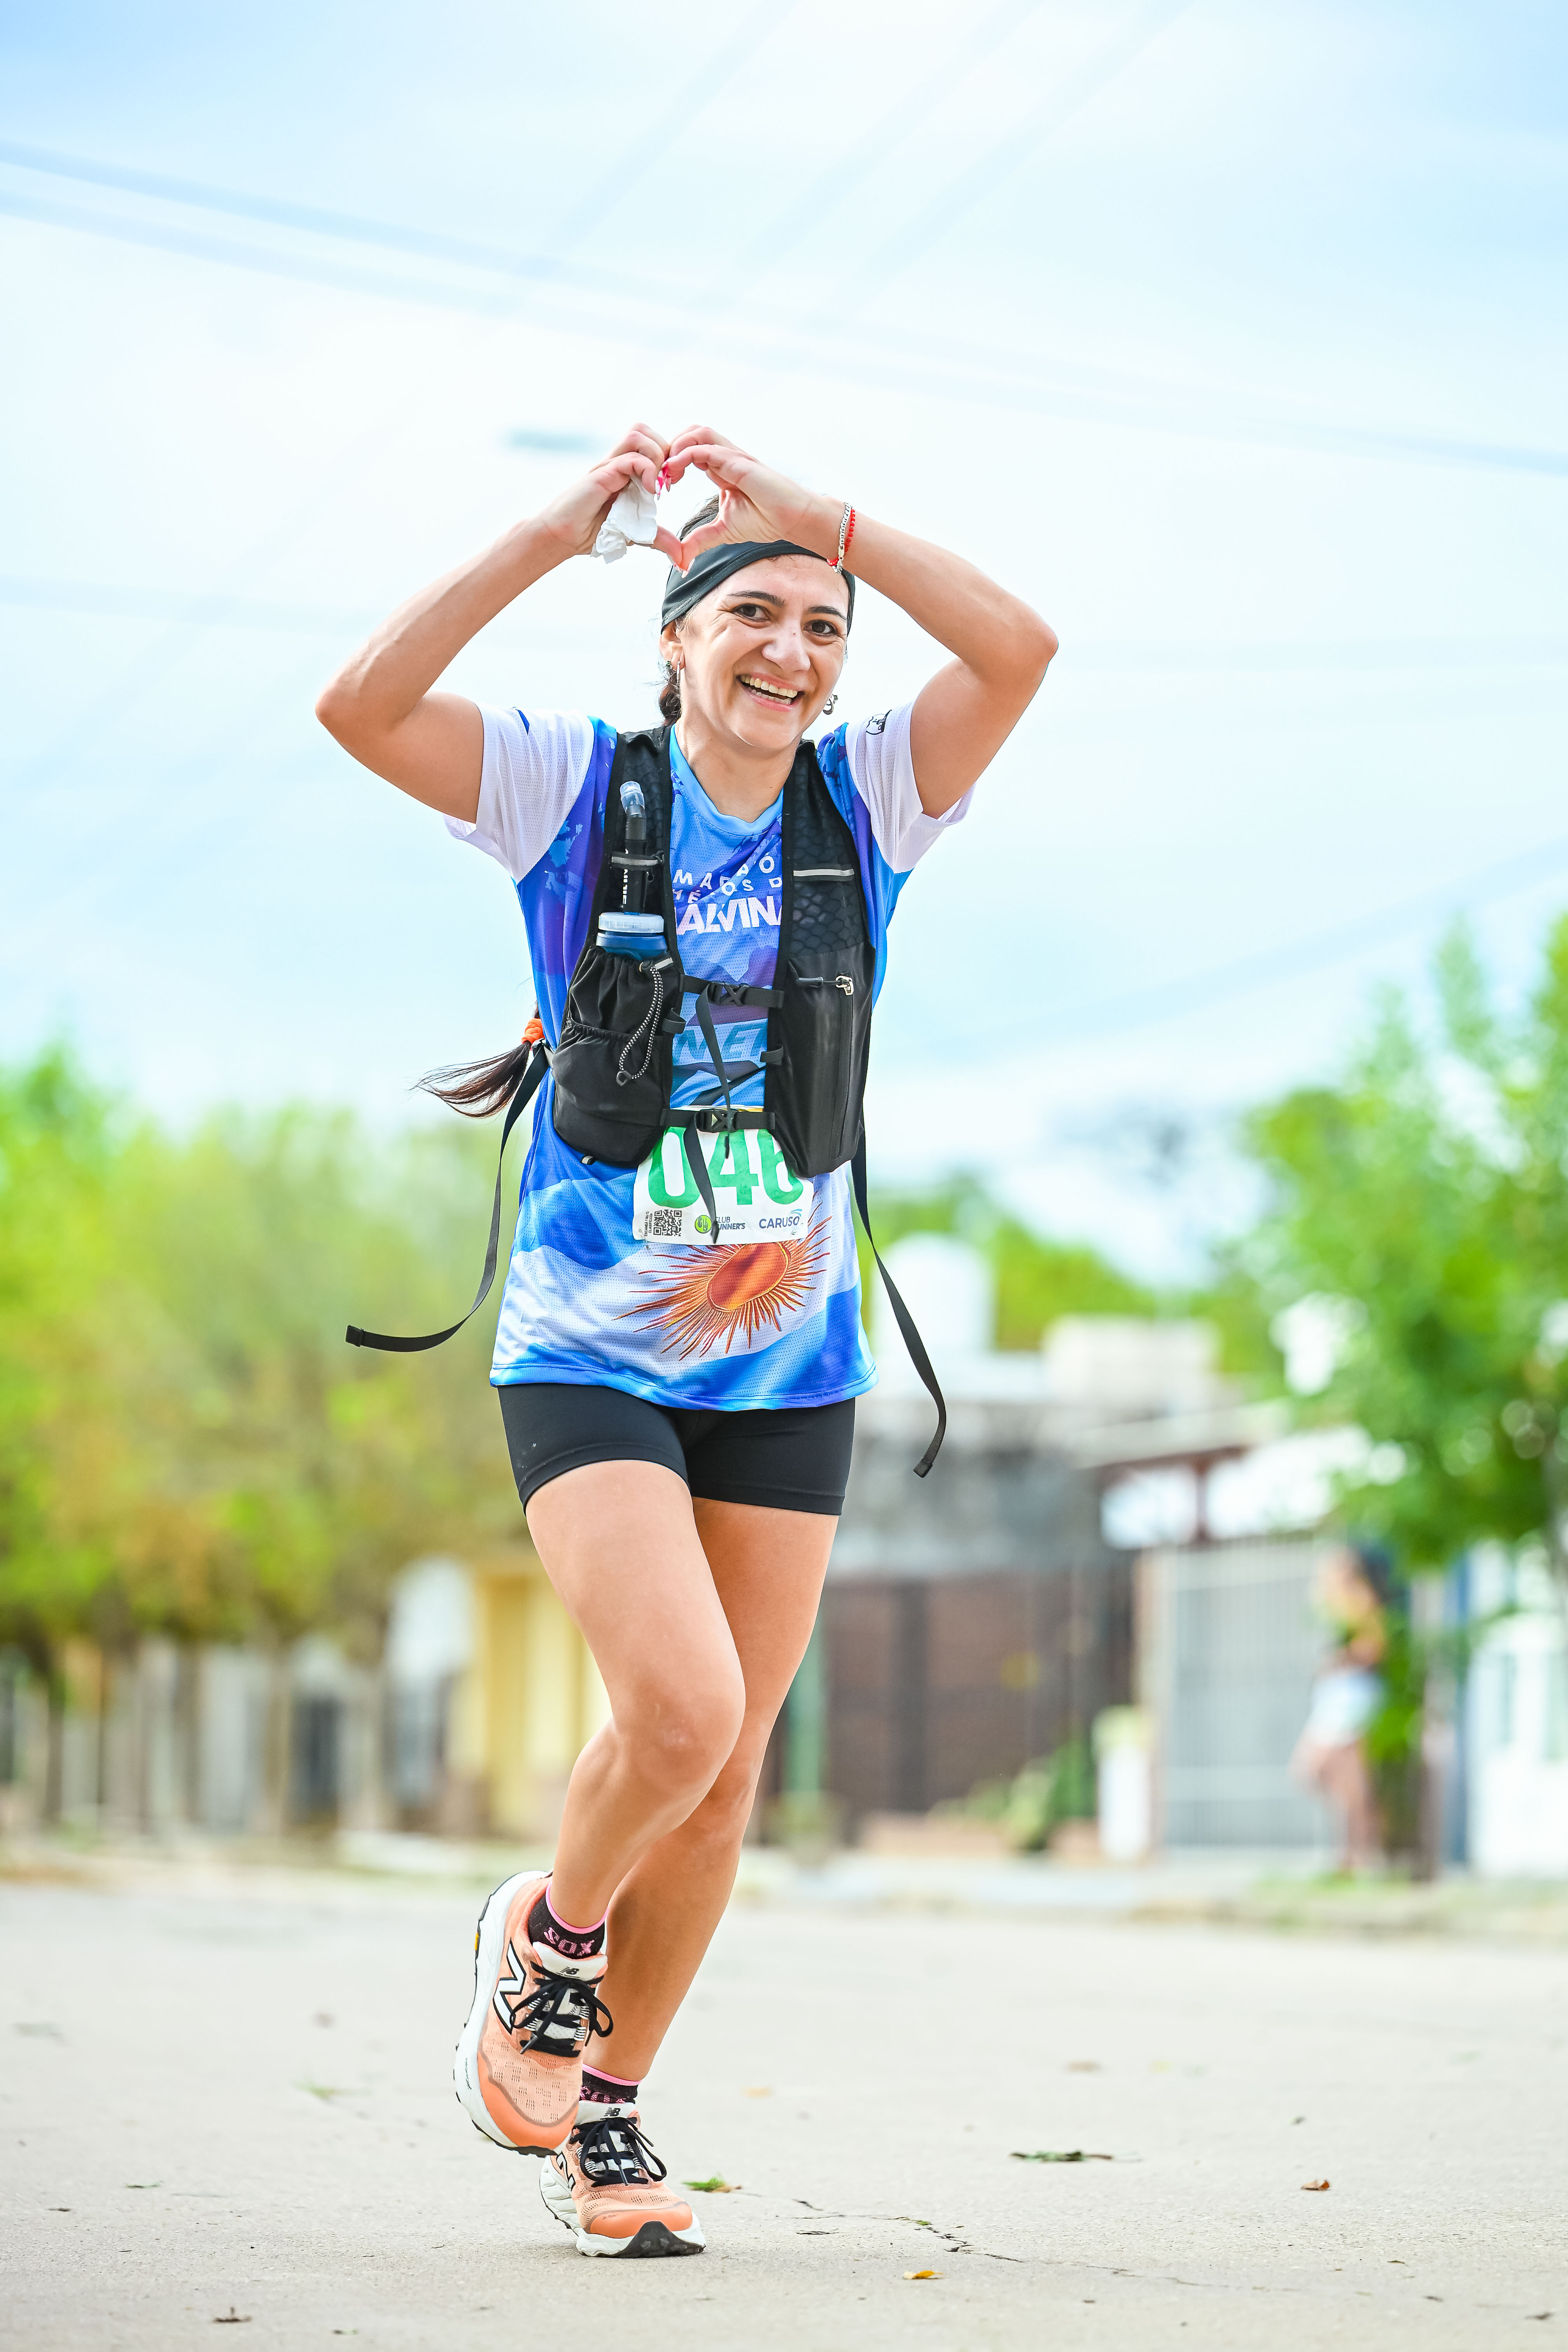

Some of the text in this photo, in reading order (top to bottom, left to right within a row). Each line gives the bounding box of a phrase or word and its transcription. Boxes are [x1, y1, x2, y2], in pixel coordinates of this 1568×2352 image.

[674, 896, 782, 936] ALVIN
[648, 1126, 804, 1209] 046
[759, 1216, 800, 1229] CARUSO
